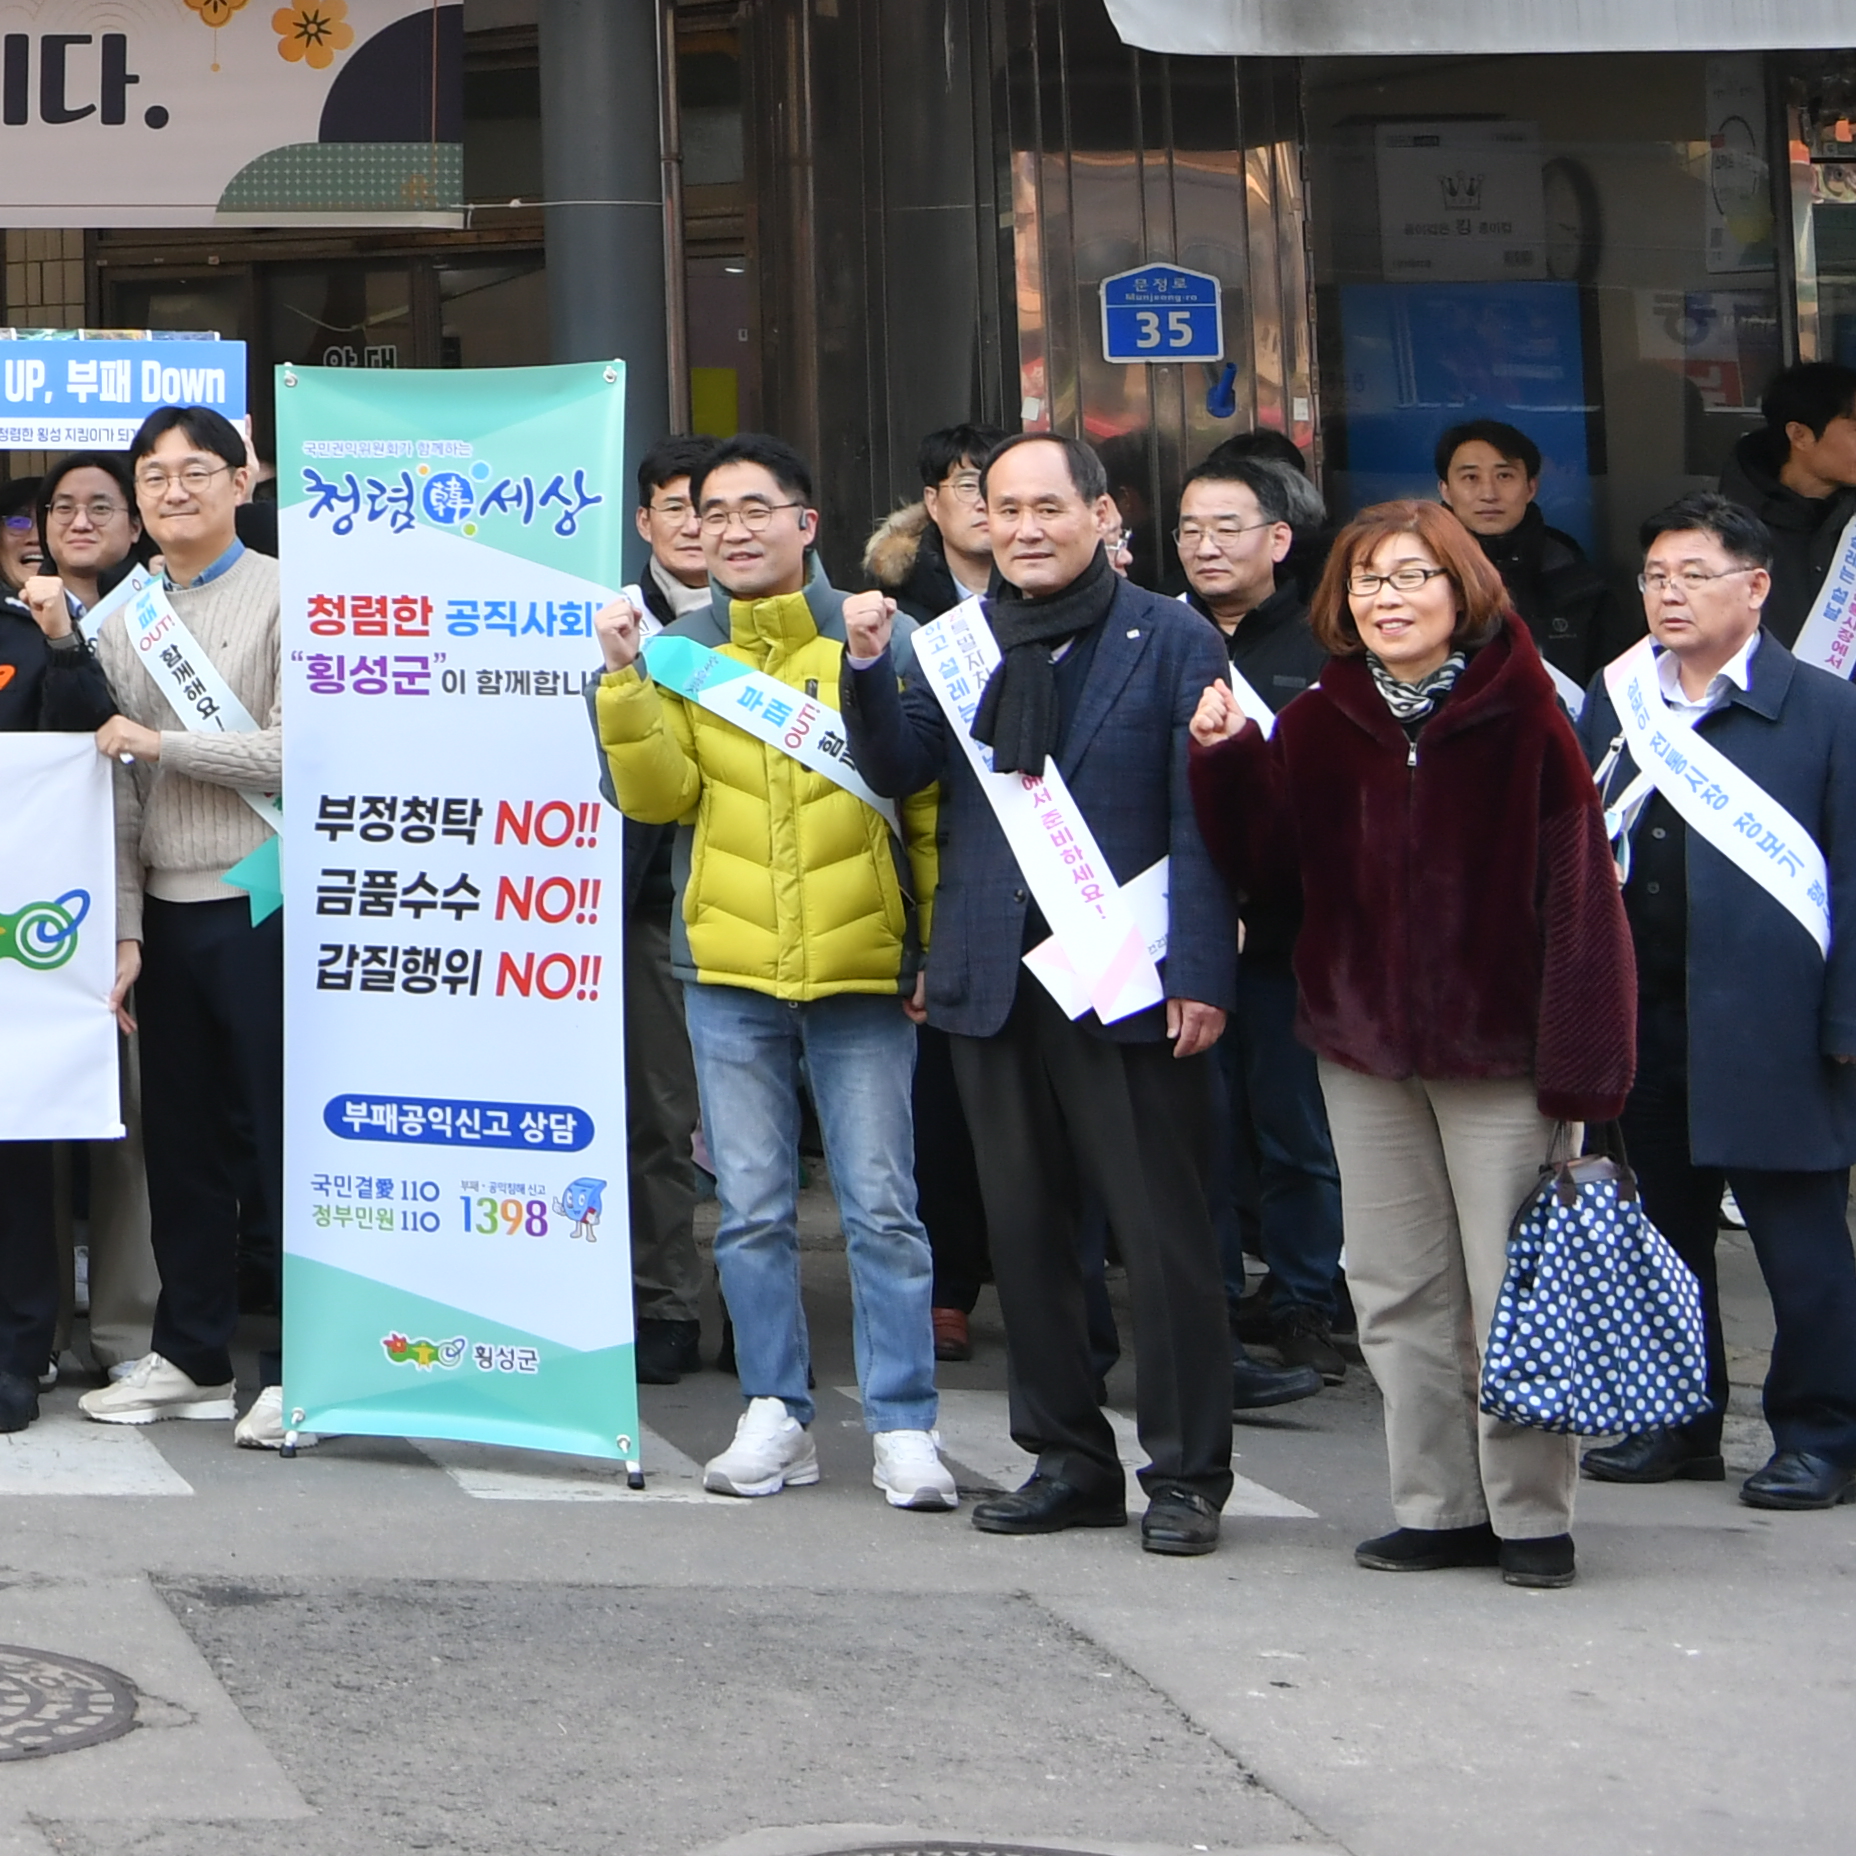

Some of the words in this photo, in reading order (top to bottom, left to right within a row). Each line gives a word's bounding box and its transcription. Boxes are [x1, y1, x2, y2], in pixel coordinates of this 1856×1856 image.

[1133, 277, 1187, 292] 문정로
[1136, 311, 1193, 348] 35
[5, 359, 53, 404] UP,
[66, 359, 132, 403] 부패
[141, 360, 226, 404] Down
[37, 426, 62, 443] 횡성
[64, 426, 115, 443] 지킴이가
[138, 613, 178, 653] OUT!
[306, 594, 434, 637] 청렴한
[445, 599, 604, 638] 공직사회
[157, 641, 225, 732] 함께해요!
[314, 794, 484, 846] 부정청탁
[494, 799, 601, 849] NO!!
[1648, 729, 1730, 811] 전통시장
[1732, 811, 1806, 880] 장보기
[1040, 808, 1108, 921] 준비하세요!
[315, 868, 481, 922] 금품수수
[495, 875, 602, 925] NO!!
[315, 943, 483, 997] 갑질행위
[495, 951, 602, 1002] NO!!
[341, 1100, 512, 1140] 부패공익신고
[518, 1110, 577, 1145] 상담
[400, 1179, 441, 1202] 110
[311, 1204, 394, 1231] 정부민원
[400, 1210, 441, 1233] 110
[459, 1195, 549, 1237] 1398
[474, 1345, 539, 1372] 횡성군
